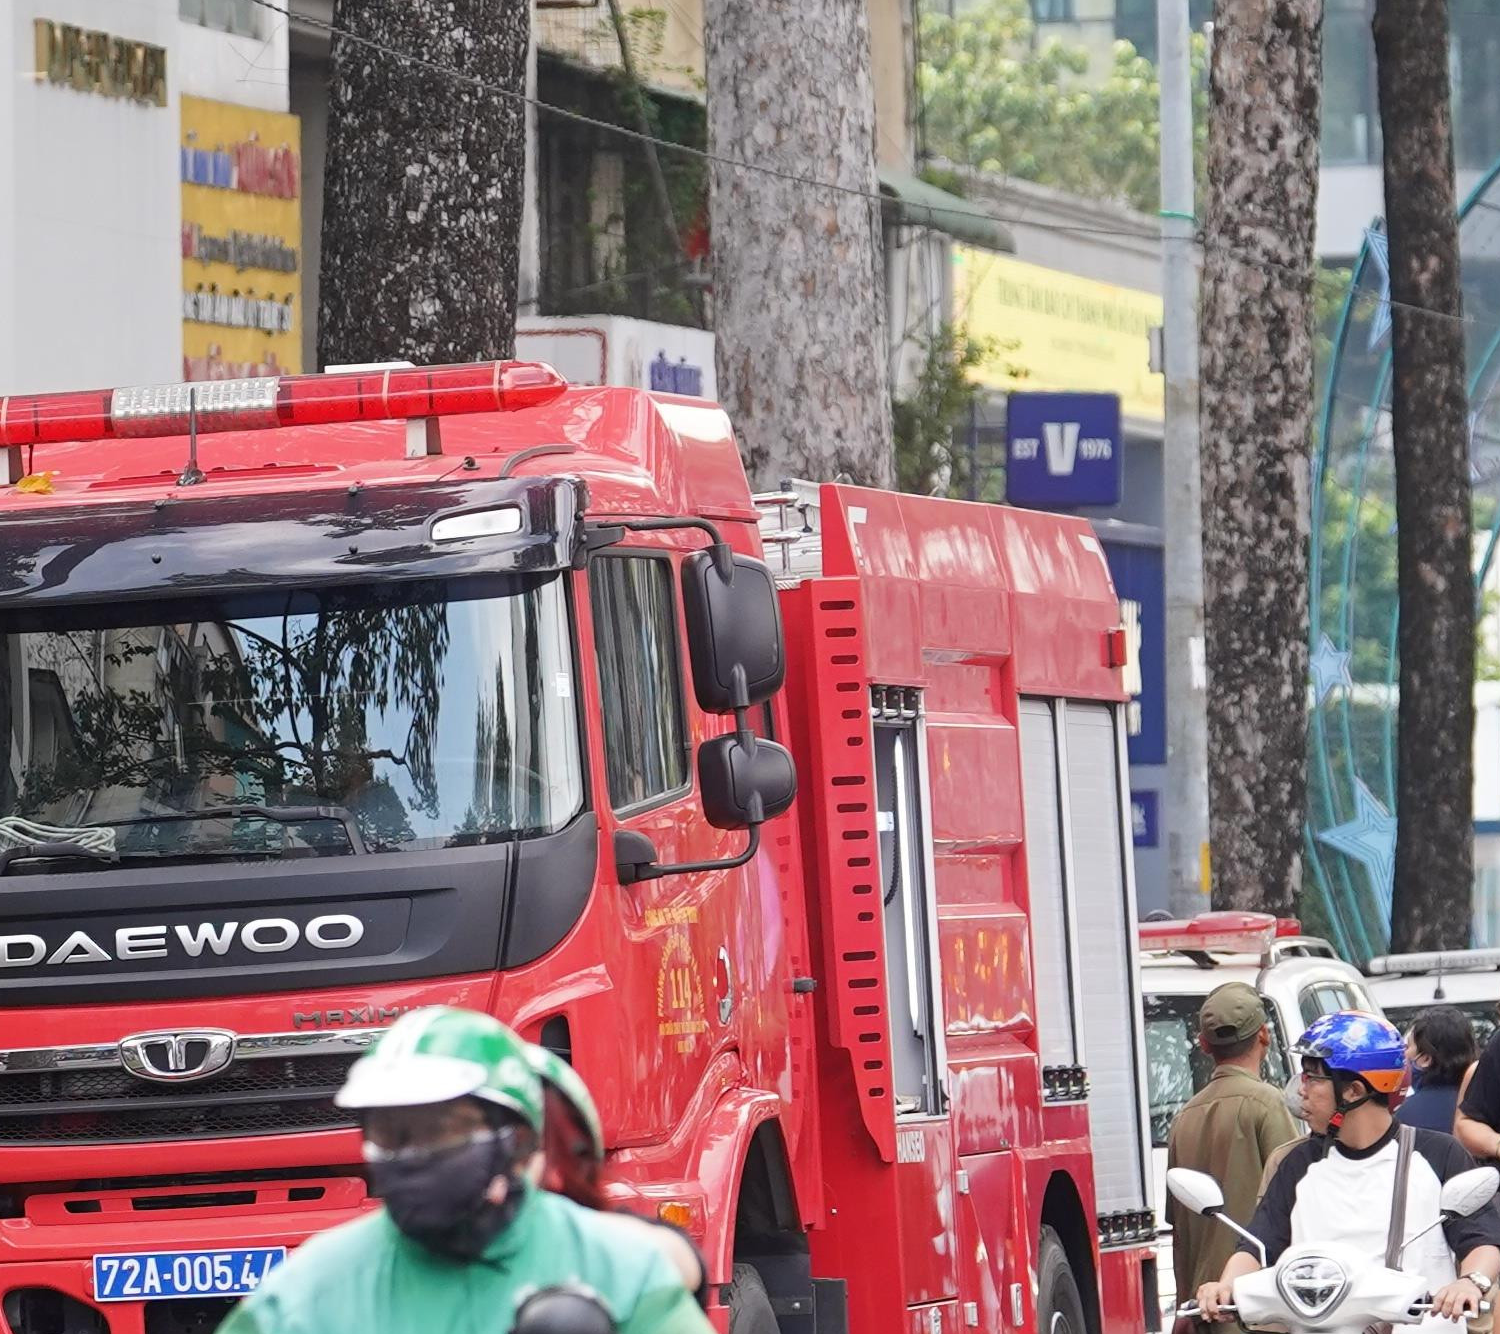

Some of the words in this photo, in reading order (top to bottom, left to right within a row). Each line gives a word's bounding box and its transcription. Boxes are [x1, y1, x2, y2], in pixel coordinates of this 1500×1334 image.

[1042, 422, 1081, 477] V
[669, 966, 693, 1009] 114
[293, 1005, 420, 1030] MAXIM
